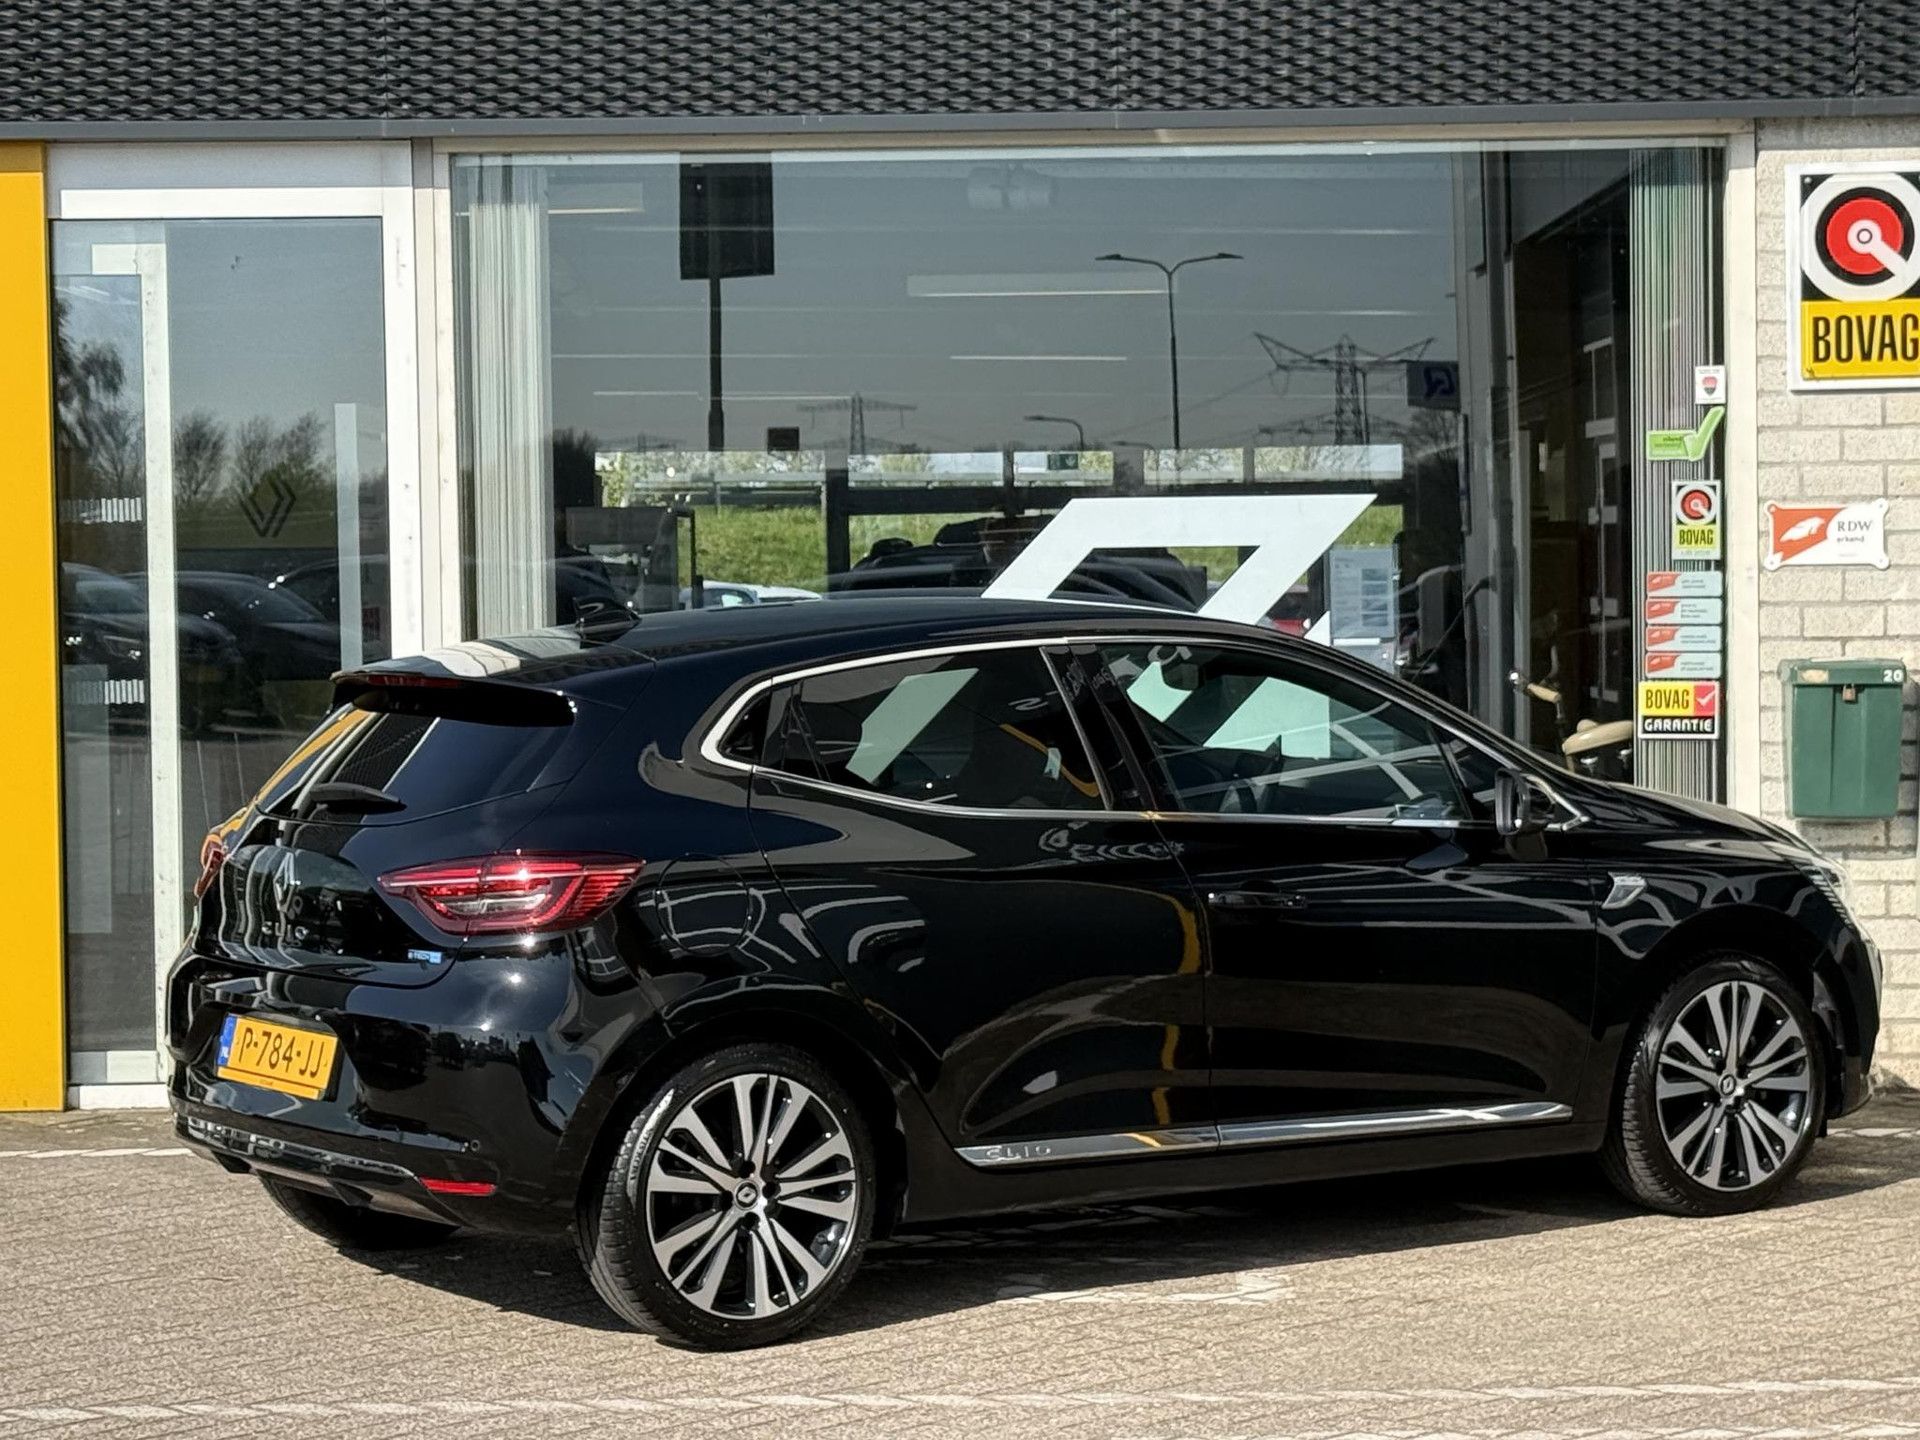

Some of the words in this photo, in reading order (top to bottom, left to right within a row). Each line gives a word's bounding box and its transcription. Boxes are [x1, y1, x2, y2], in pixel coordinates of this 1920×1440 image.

[1812, 313, 1919, 364] BOVAG
[1837, 520, 1873, 532] RDW
[1678, 528, 1714, 545] BOVAG
[1882, 669, 1904, 683] 20
[1645, 688, 1690, 709] BOVAG
[1644, 717, 1713, 733] GARANTIE
[238, 1026, 325, 1078] P-784-JJ
